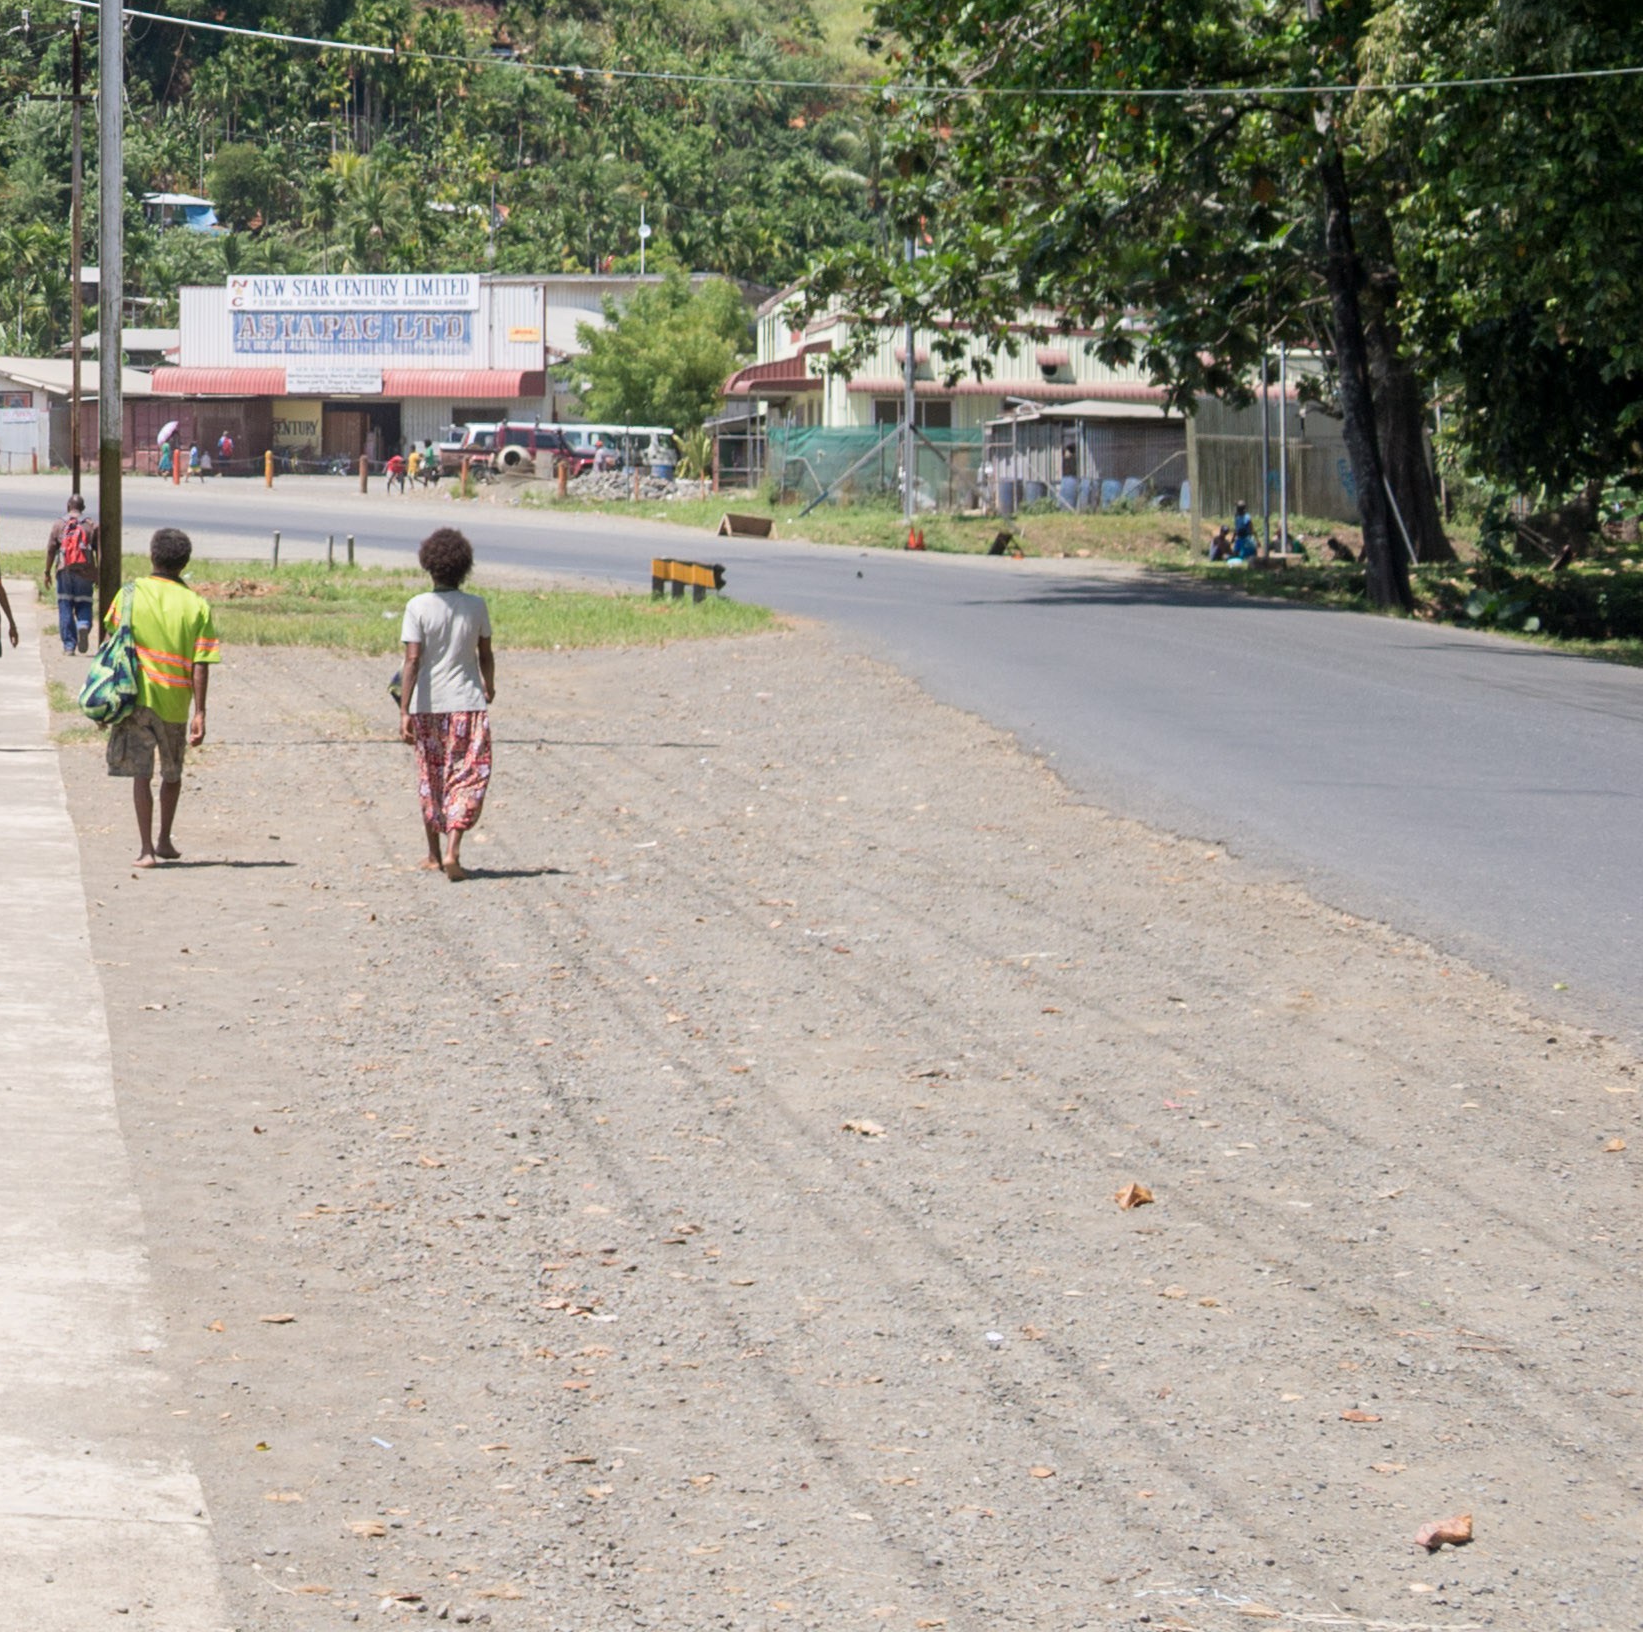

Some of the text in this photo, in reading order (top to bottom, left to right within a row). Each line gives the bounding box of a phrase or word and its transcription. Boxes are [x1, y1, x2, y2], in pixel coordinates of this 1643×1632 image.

[253, 278, 470, 296] NEW STAR CENTURY LIMITED
[238, 314, 464, 341] ASIAPAC LTD
